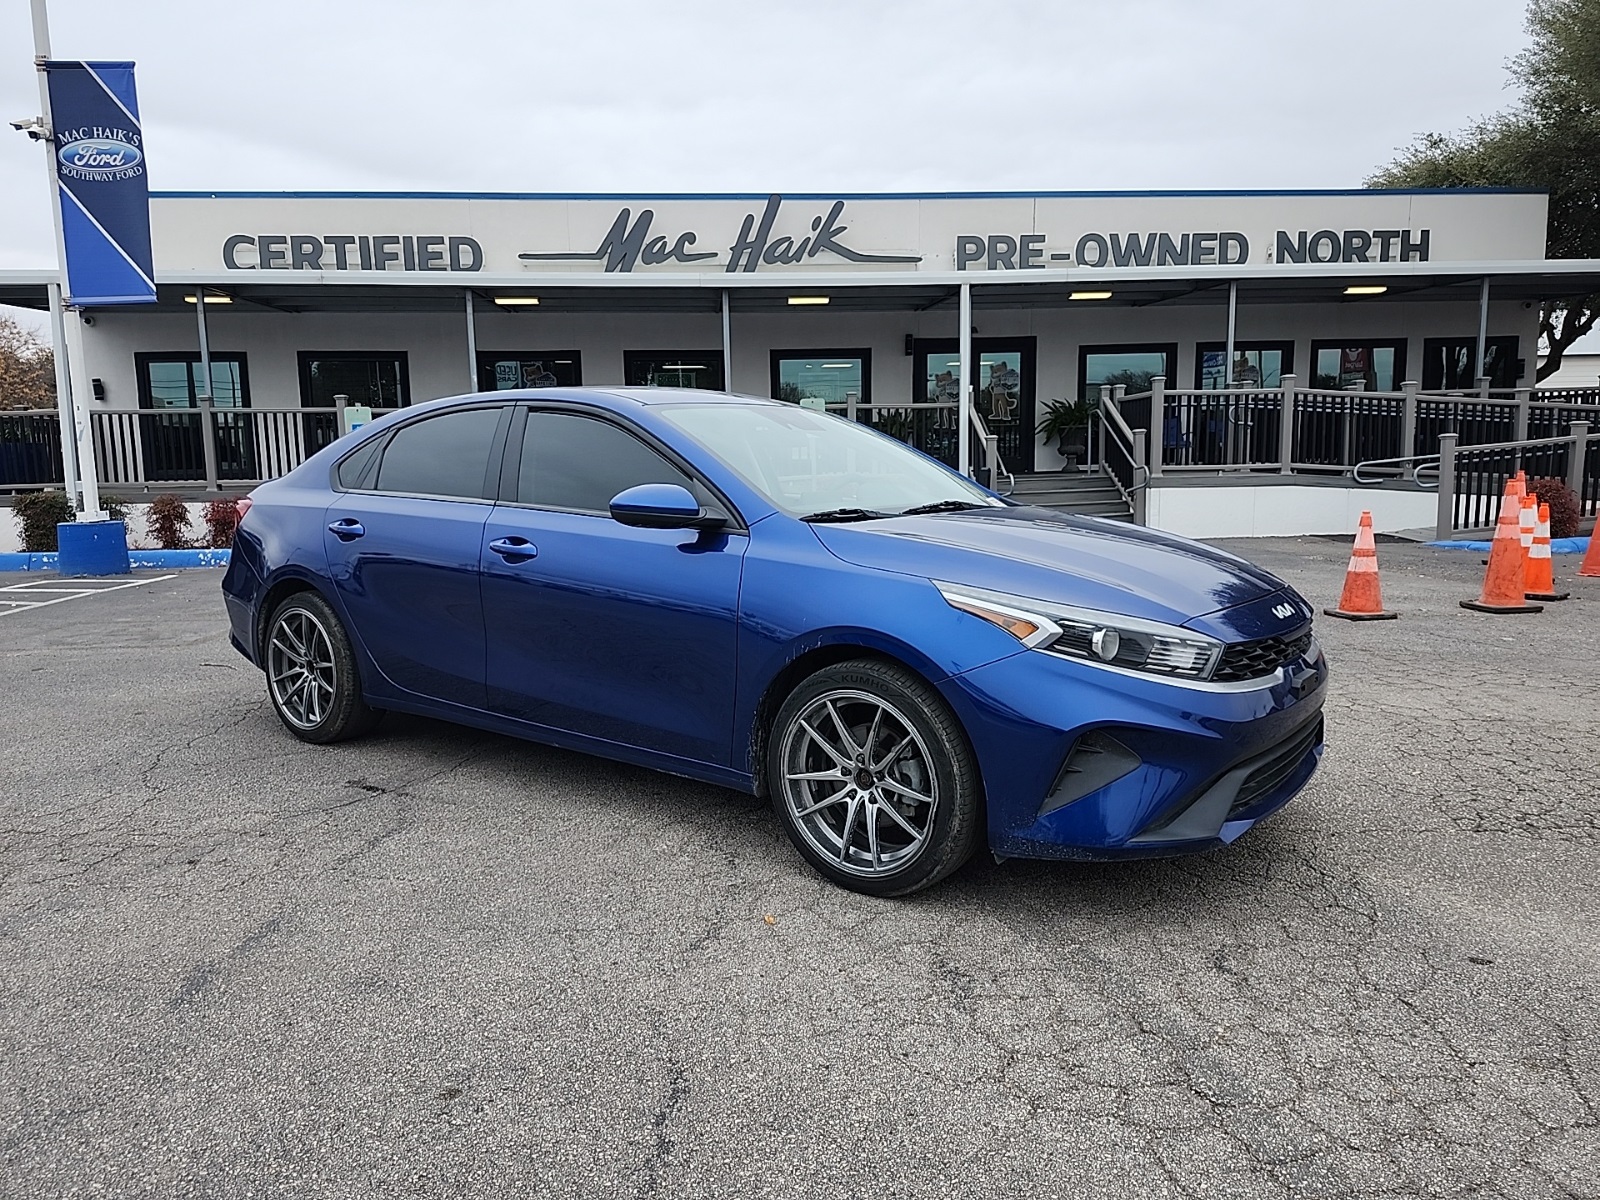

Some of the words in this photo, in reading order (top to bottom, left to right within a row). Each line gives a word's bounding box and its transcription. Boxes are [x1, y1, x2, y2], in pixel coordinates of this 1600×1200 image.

[57, 127, 89, 144] MAC
[92, 126, 140, 146] HAIK'S
[74, 144, 126, 166] Ford
[60, 165, 114, 181] SOUTHWAY
[115, 166, 142, 180] FORD
[518, 207, 718, 273] Mac
[724, 194, 923, 273] Haik
[222, 234, 484, 272] CERTIFIED
[956, 231, 1250, 271] PRE-OWNED
[1275, 229, 1431, 264] NORTH
[841, 674, 888, 691] KUMHO
